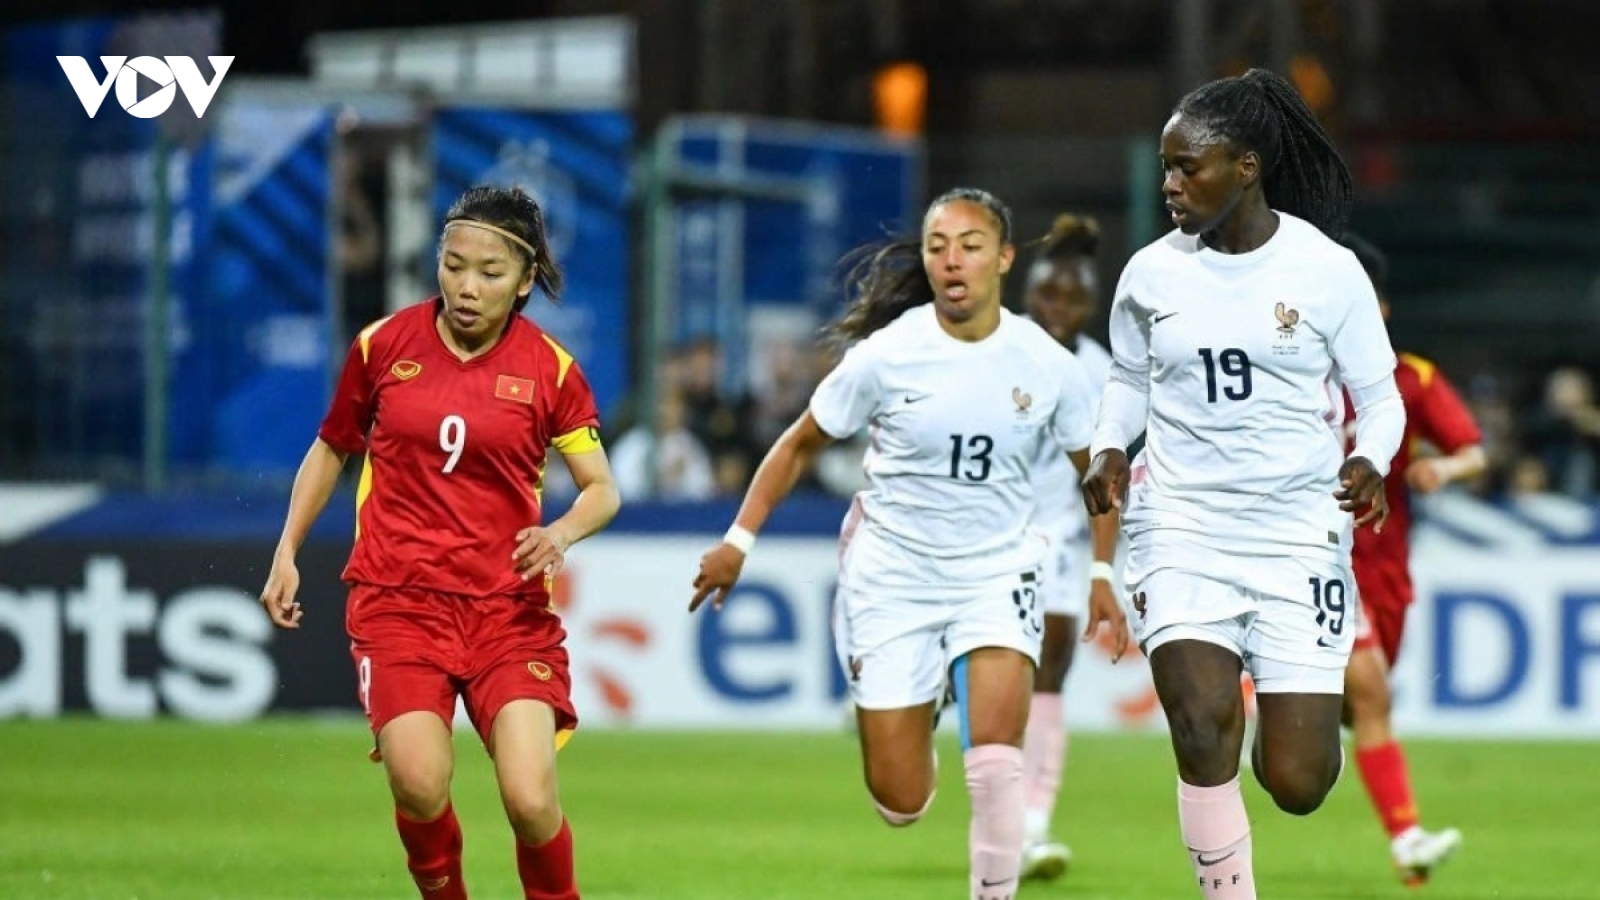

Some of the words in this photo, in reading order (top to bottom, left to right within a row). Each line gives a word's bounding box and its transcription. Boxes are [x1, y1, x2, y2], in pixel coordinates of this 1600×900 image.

[1198, 347, 1254, 402] 19
[440, 415, 466, 473] 9
[949, 434, 994, 481] 13
[1308, 577, 1345, 634] 19
